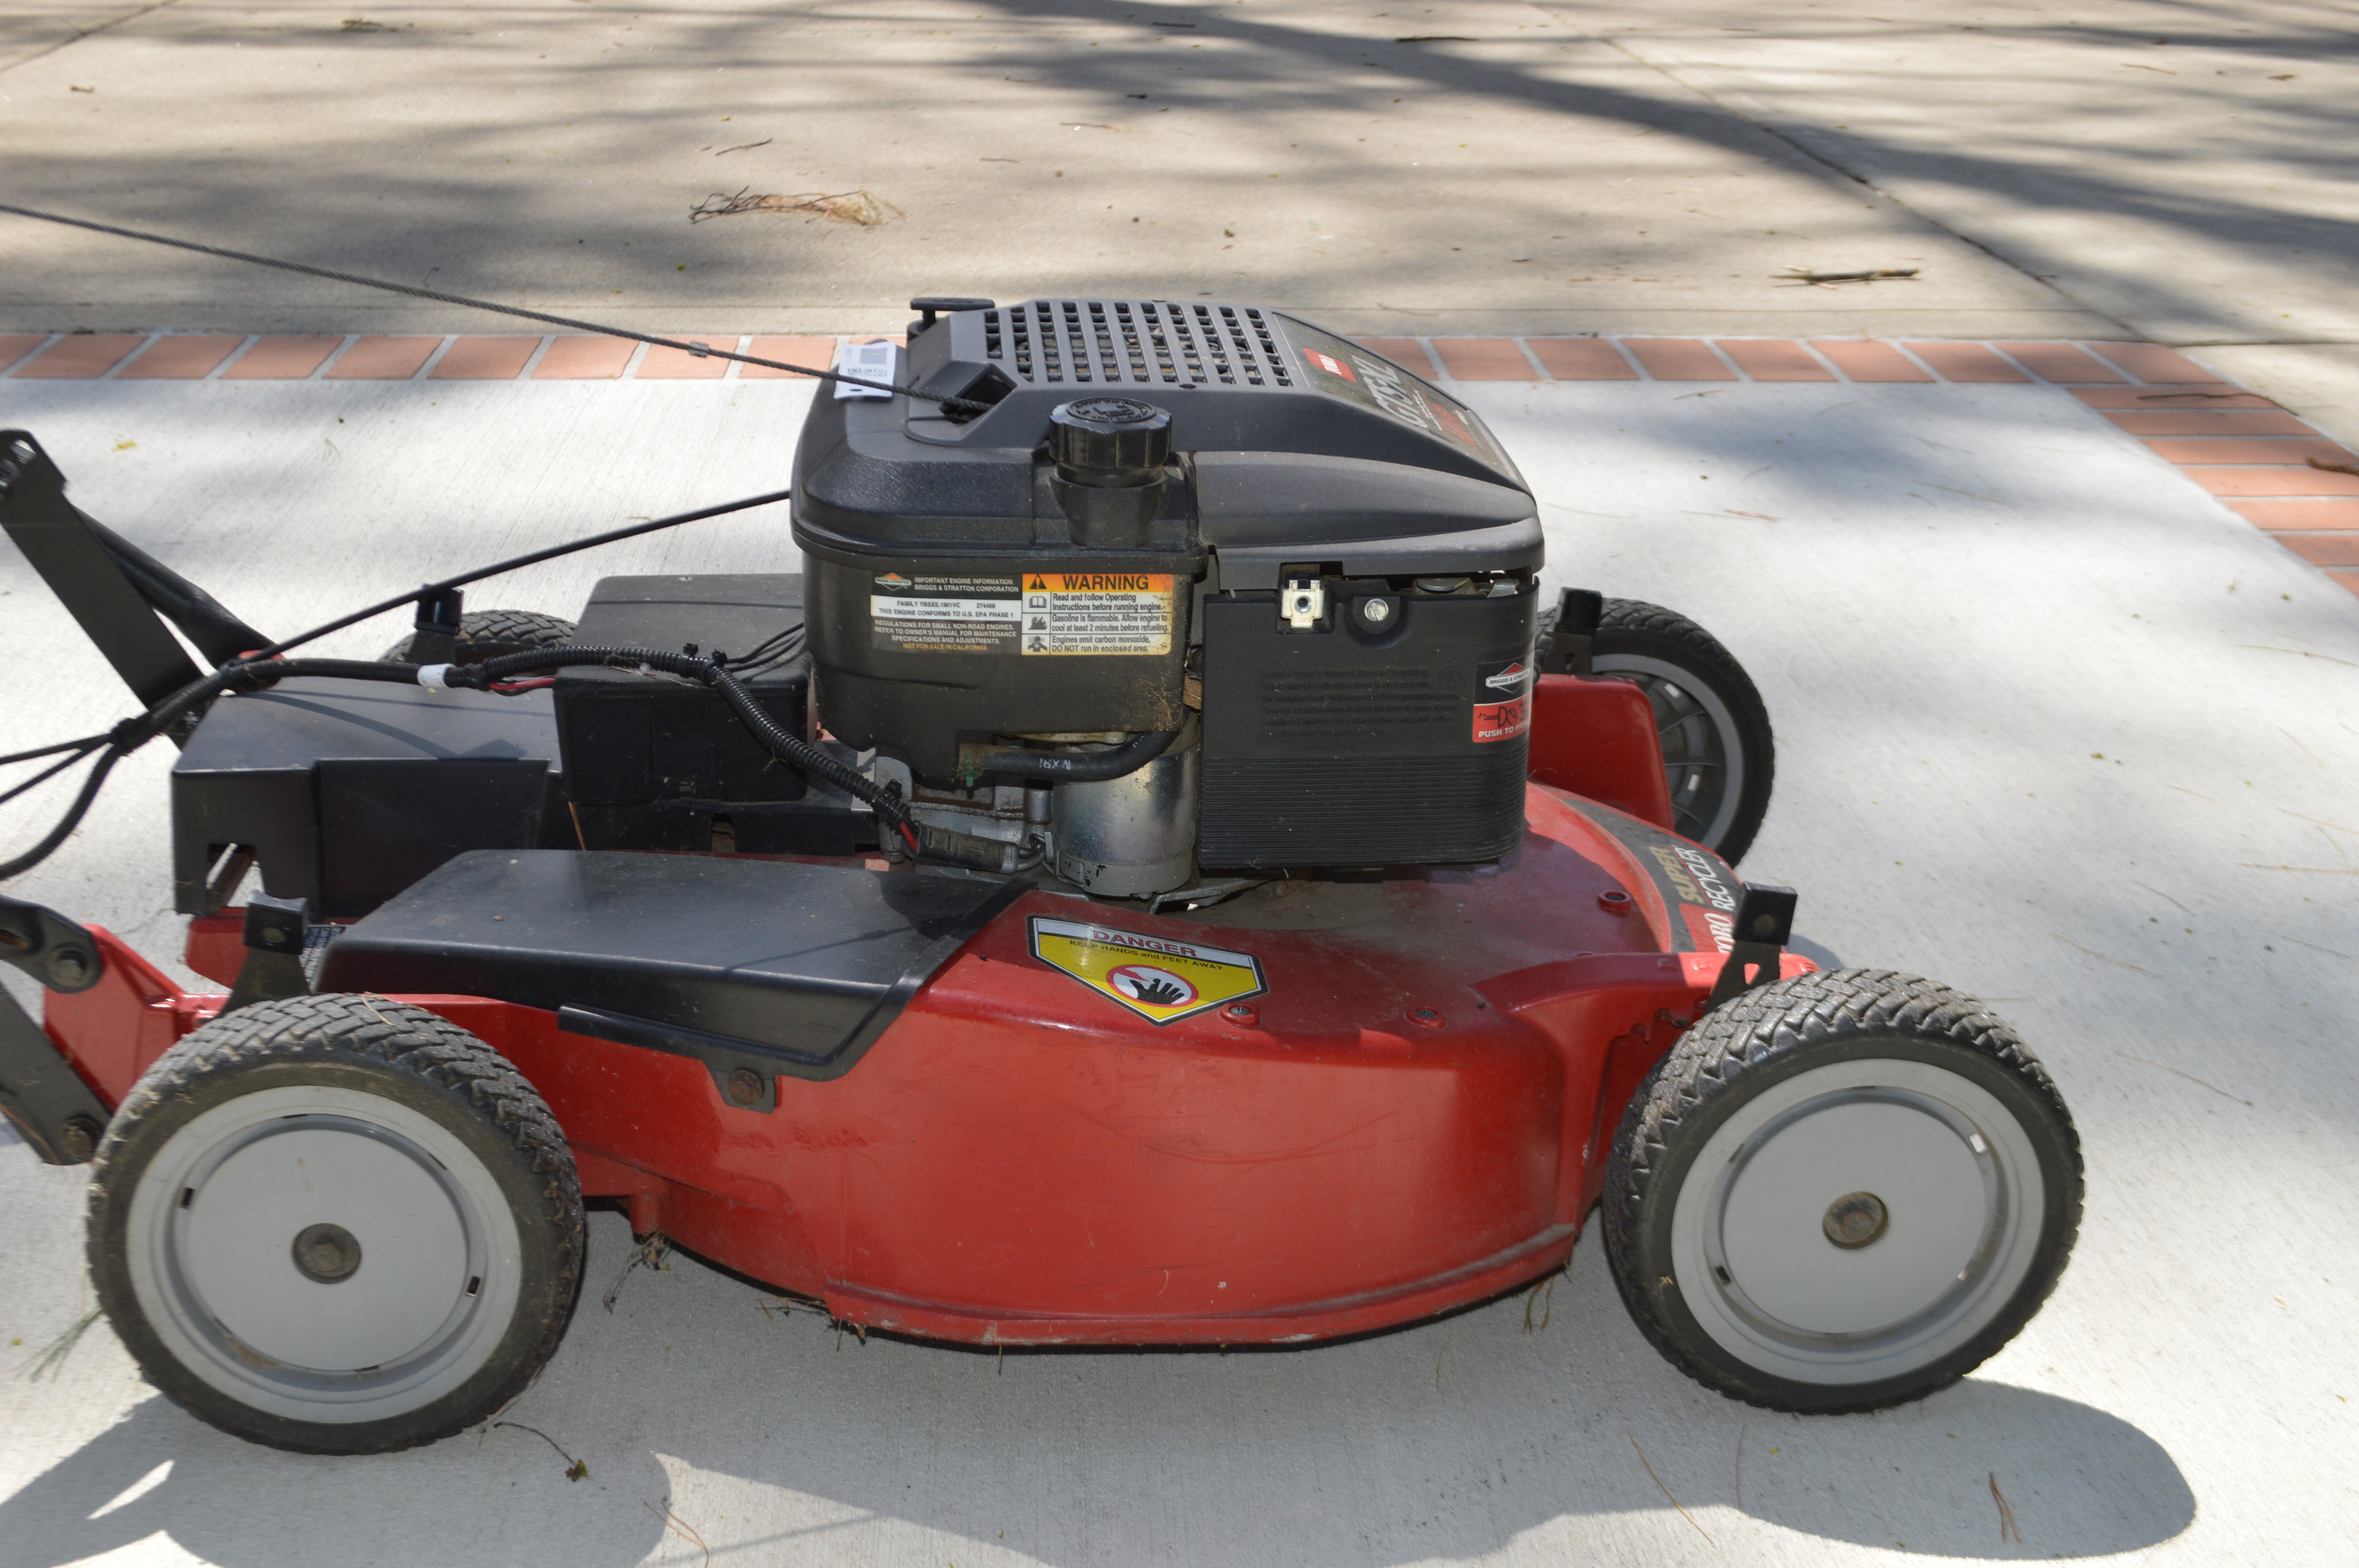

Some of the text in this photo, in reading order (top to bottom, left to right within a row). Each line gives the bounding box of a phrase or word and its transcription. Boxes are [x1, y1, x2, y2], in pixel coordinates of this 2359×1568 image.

[1063, 575, 1149, 590] WARNING
[1105, 594, 1136, 603] Operating
[1114, 604, 1138, 613] running
[1140, 604, 1162, 613] engine.
[1087, 614, 1120, 622] flammable.
[1140, 615, 1160, 624] engine
[1141, 624, 1169, 633] refueling.
[1052, 636, 1078, 644] Engines
[1118, 636, 1150, 644] monoxide,
[1479, 729, 1502, 737] PUSH
[1649, 846, 1705, 904] SUPER
[1674, 847, 1736, 911] RECYCLER
[1093, 930, 1197, 957] DANGER
[1070, 940, 1098, 949] KEEP
[1101, 944, 1138, 956] HANDS
[1162, 954, 1189, 964] FEET
[1192, 961, 1222, 970] AWAY
